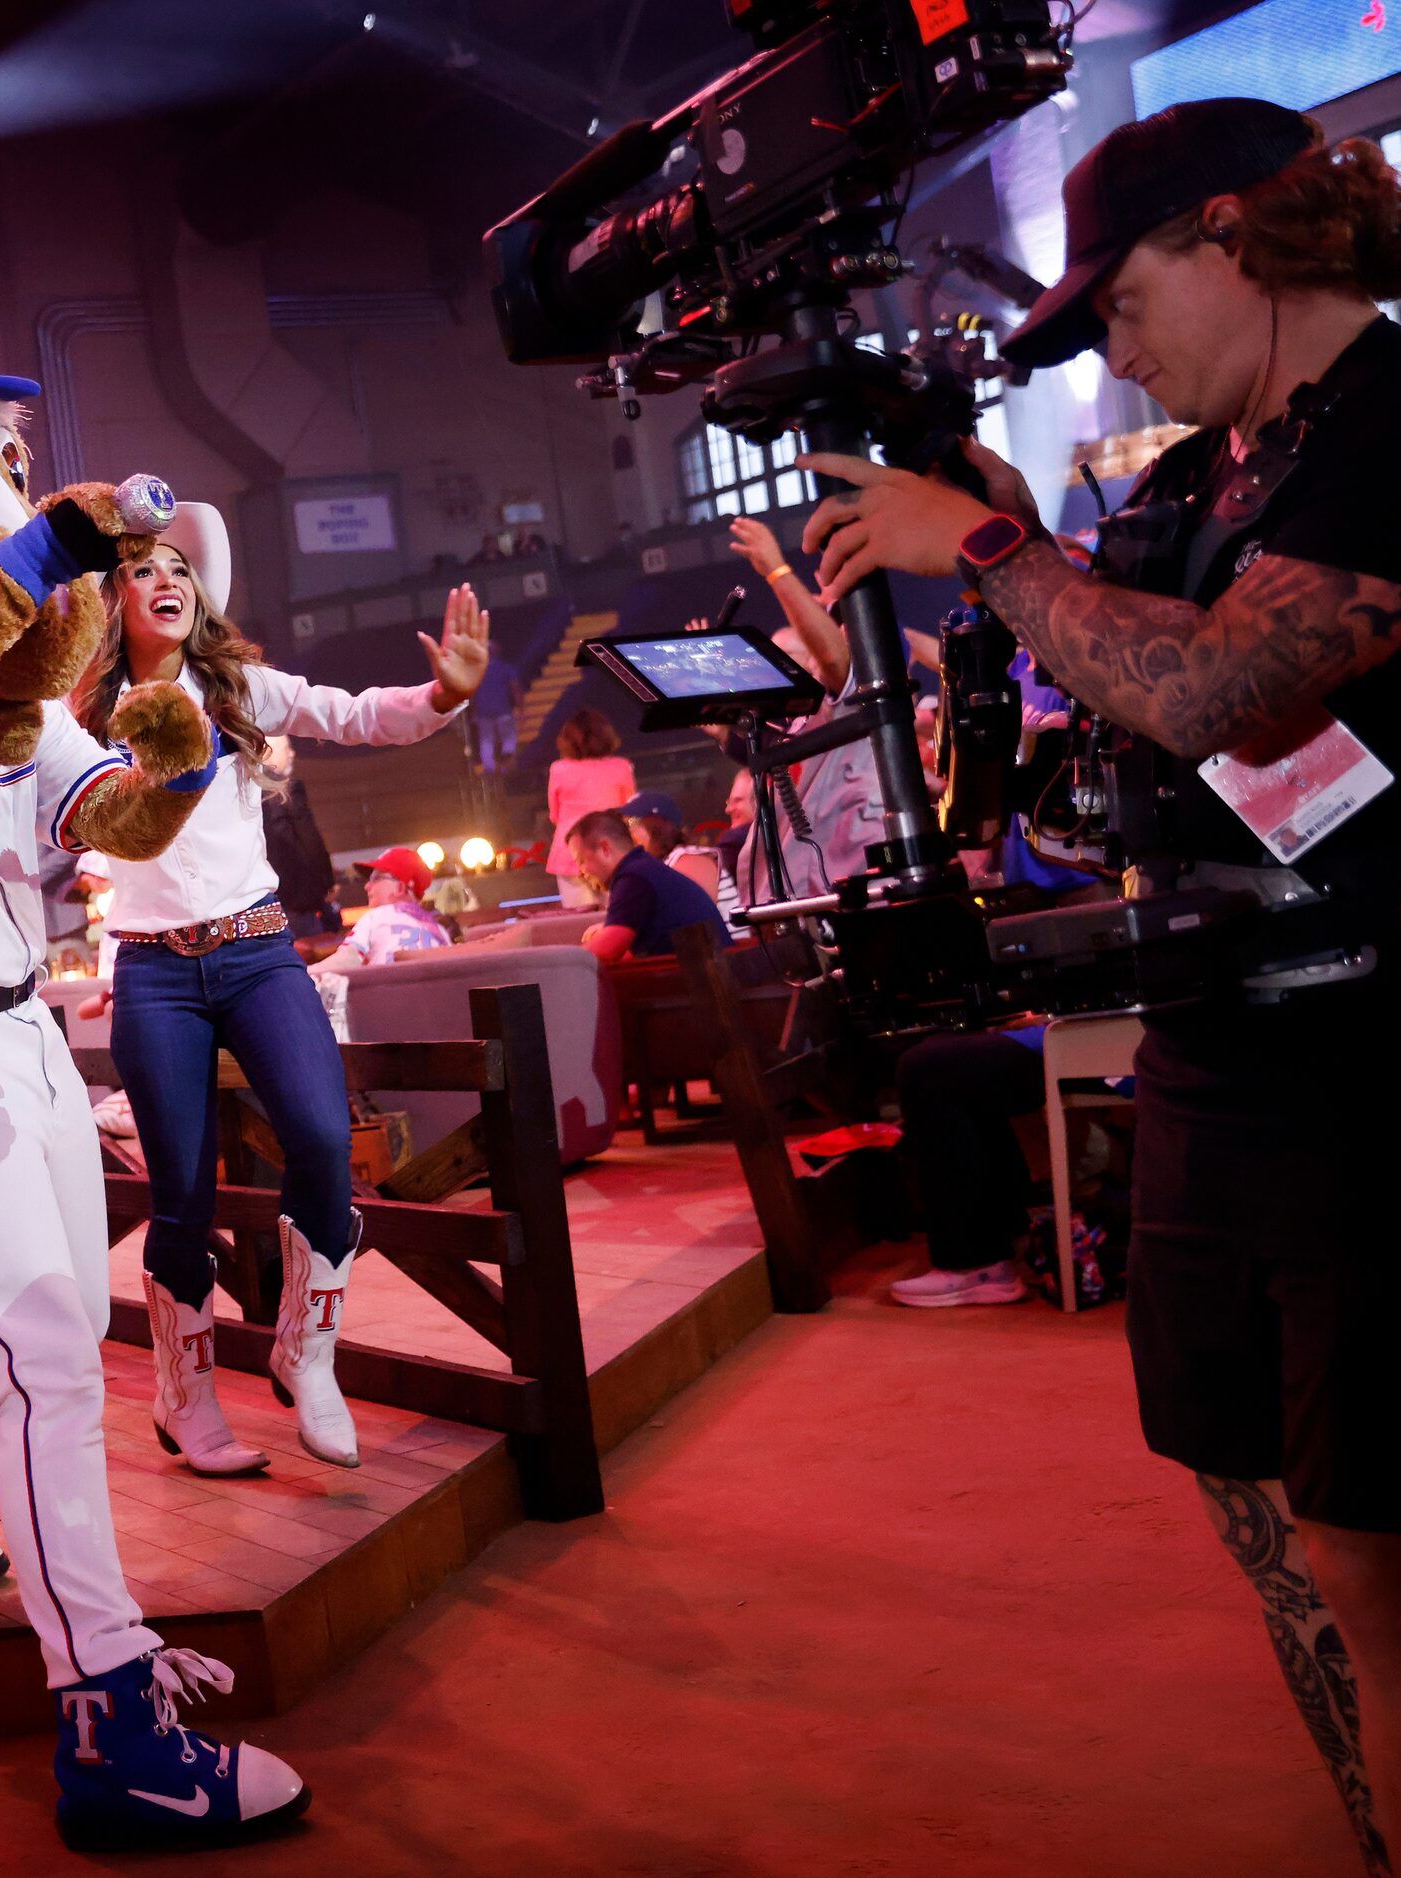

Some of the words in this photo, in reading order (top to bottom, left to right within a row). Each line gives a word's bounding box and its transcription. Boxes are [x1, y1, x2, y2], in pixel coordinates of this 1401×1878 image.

[310, 1287, 344, 1332] T
[182, 1327, 214, 1374] T
[61, 1691, 115, 1765] T
